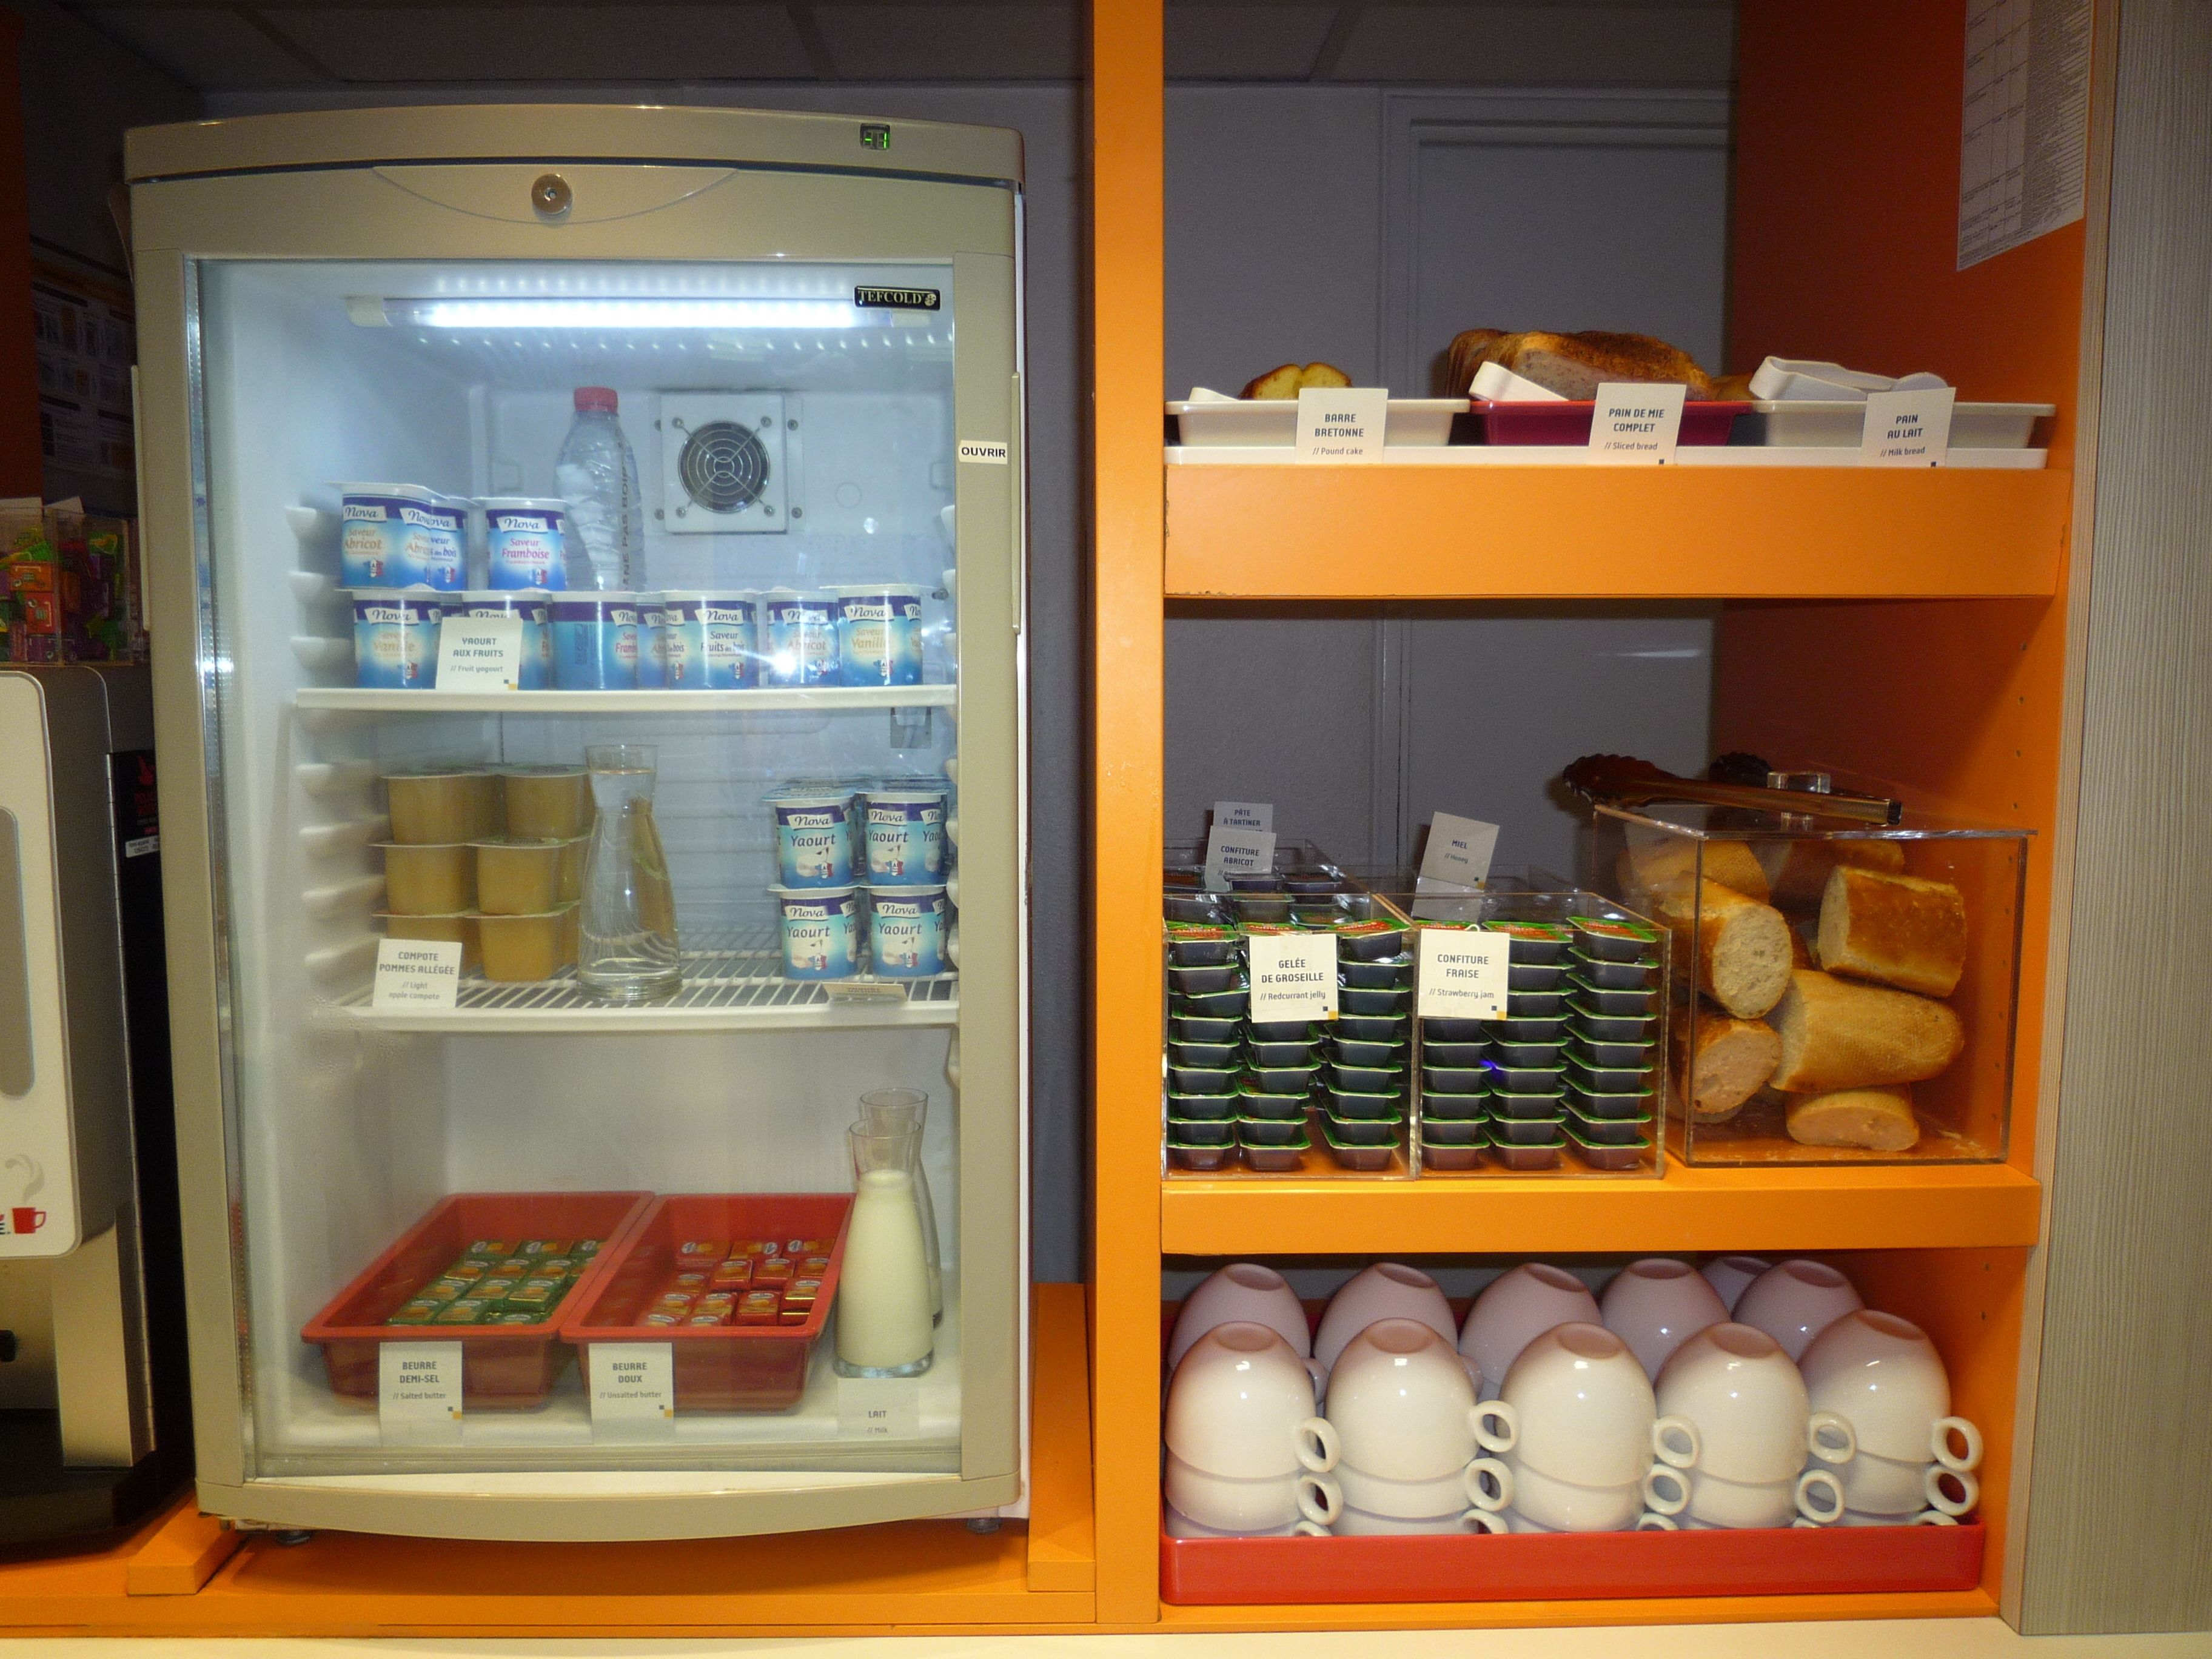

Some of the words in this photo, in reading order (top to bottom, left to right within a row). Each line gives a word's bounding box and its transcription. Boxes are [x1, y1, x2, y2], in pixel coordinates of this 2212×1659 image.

[858, 290, 922, 304] TEFCOLD
[1325, 414, 1356, 423] BARRE
[1609, 409, 1632, 417] PAIN
[1634, 409, 1646, 418] DE
[1648, 409, 1665, 418] MIE
[1895, 414, 1919, 424] PAIN
[1315, 428, 1364, 437] BRETONNE
[1614, 423, 1655, 432] COMPLET
[1887, 430, 1900, 439] AU
[1903, 428, 1924, 438] LAIT
[961, 447, 1007, 458] OUVRIR
[1904, 446, 1925, 455] bread
[345, 506, 378, 518] Nova
[504, 518, 540, 529] Nova
[511, 538, 540, 546] Saveur
[502, 548, 549, 559] Framboise
[372, 609, 411, 621] Nova
[707, 610, 739, 621] Nova
[851, 606, 886, 617] Nova
[794, 816, 831, 826] Nova
[871, 810, 903, 822] Nova
[791, 833, 836, 847] Yaourt
[868, 830, 909, 843] Yaourt
[1452, 839, 1467, 849] MIEL
[1221, 846, 1260, 856] CONFITURE
[1224, 857, 1254, 866] ABRICOT
[790, 907, 825, 917] Nova
[882, 904, 918, 914] Nova
[787, 926, 830, 938] Yaourt
[879, 923, 922, 935] Yaourt
[398, 951, 438, 961] COMPOTE
[1438, 954, 1489, 965] CONFITURE
[1279, 957, 1305, 968] GELÉE
[379, 964, 415, 973] POMMES
[418, 965, 455, 975] ALLÉGÉE
[1446, 968, 1479, 978] FRAISE
[1262, 974, 1273, 983] DE
[1276, 973, 1324, 982] GROSEILLE
[410, 981, 427, 990] Light
[1268, 991, 1309, 1000] Redcurrant
[1310, 990, 1326, 1000] jelly
[1437, 988, 1478, 999] Strawberry
[1480, 990, 1494, 999] jam
[403, 1361, 437, 1370] BEURRE
[400, 1375, 440, 1384] DEMI-SEL
[618, 1375, 643, 1384] DOUX
